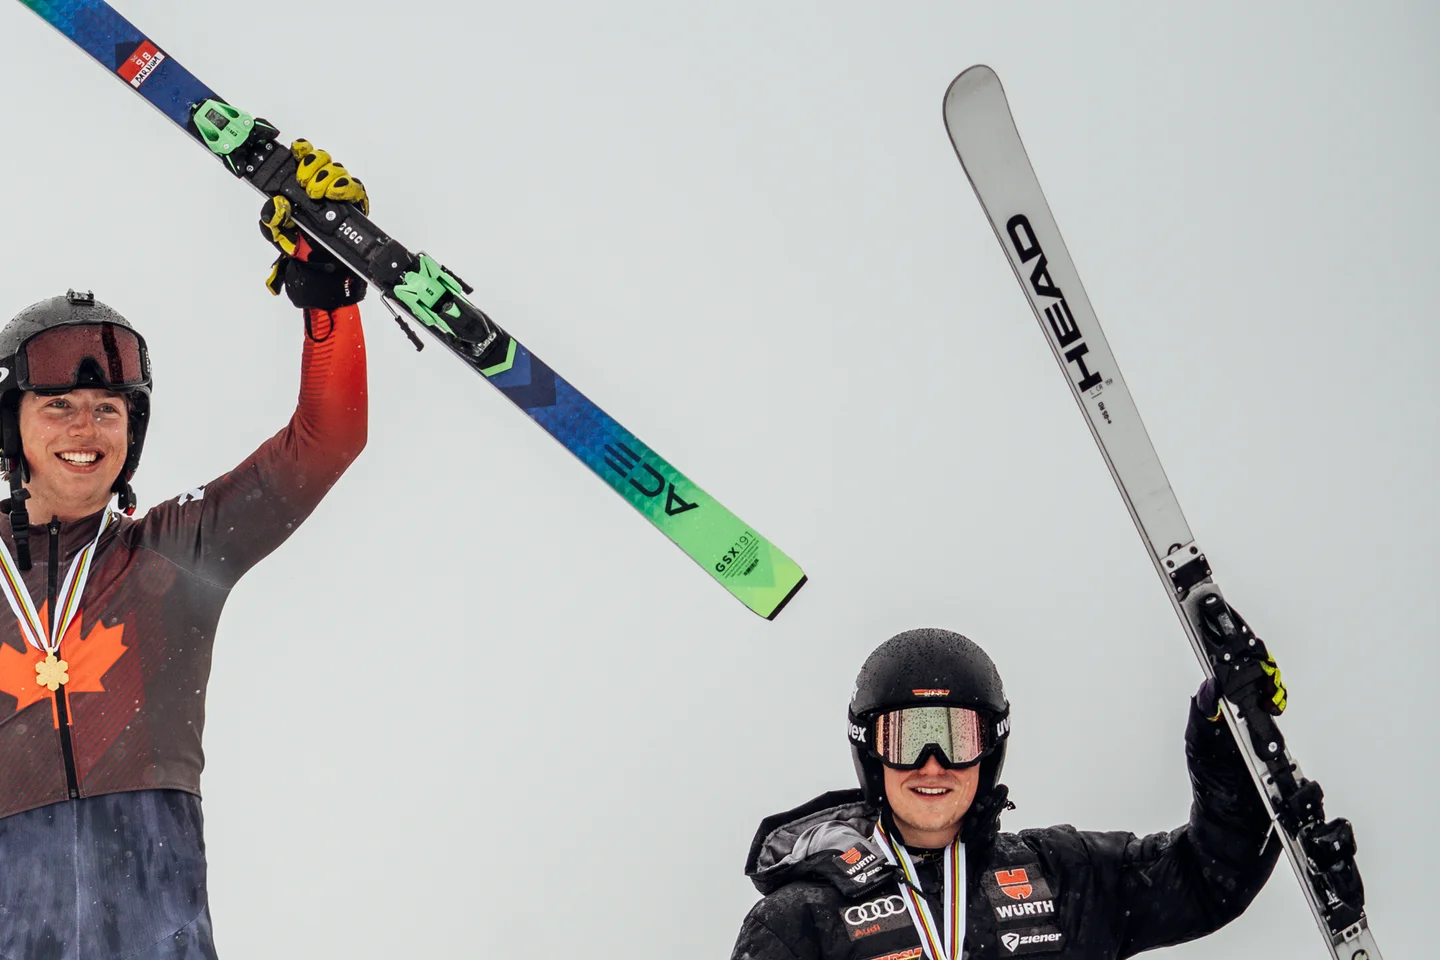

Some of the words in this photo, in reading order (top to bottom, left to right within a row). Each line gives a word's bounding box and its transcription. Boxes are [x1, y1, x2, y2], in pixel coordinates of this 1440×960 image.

[135, 51, 152, 68] 98
[1006, 213, 1103, 393] HEAD
[603, 442, 700, 516] ACE
[996, 899, 1055, 919] WÜRTH
[854, 923, 881, 937] Audi
[1019, 931, 1062, 946] ziener
